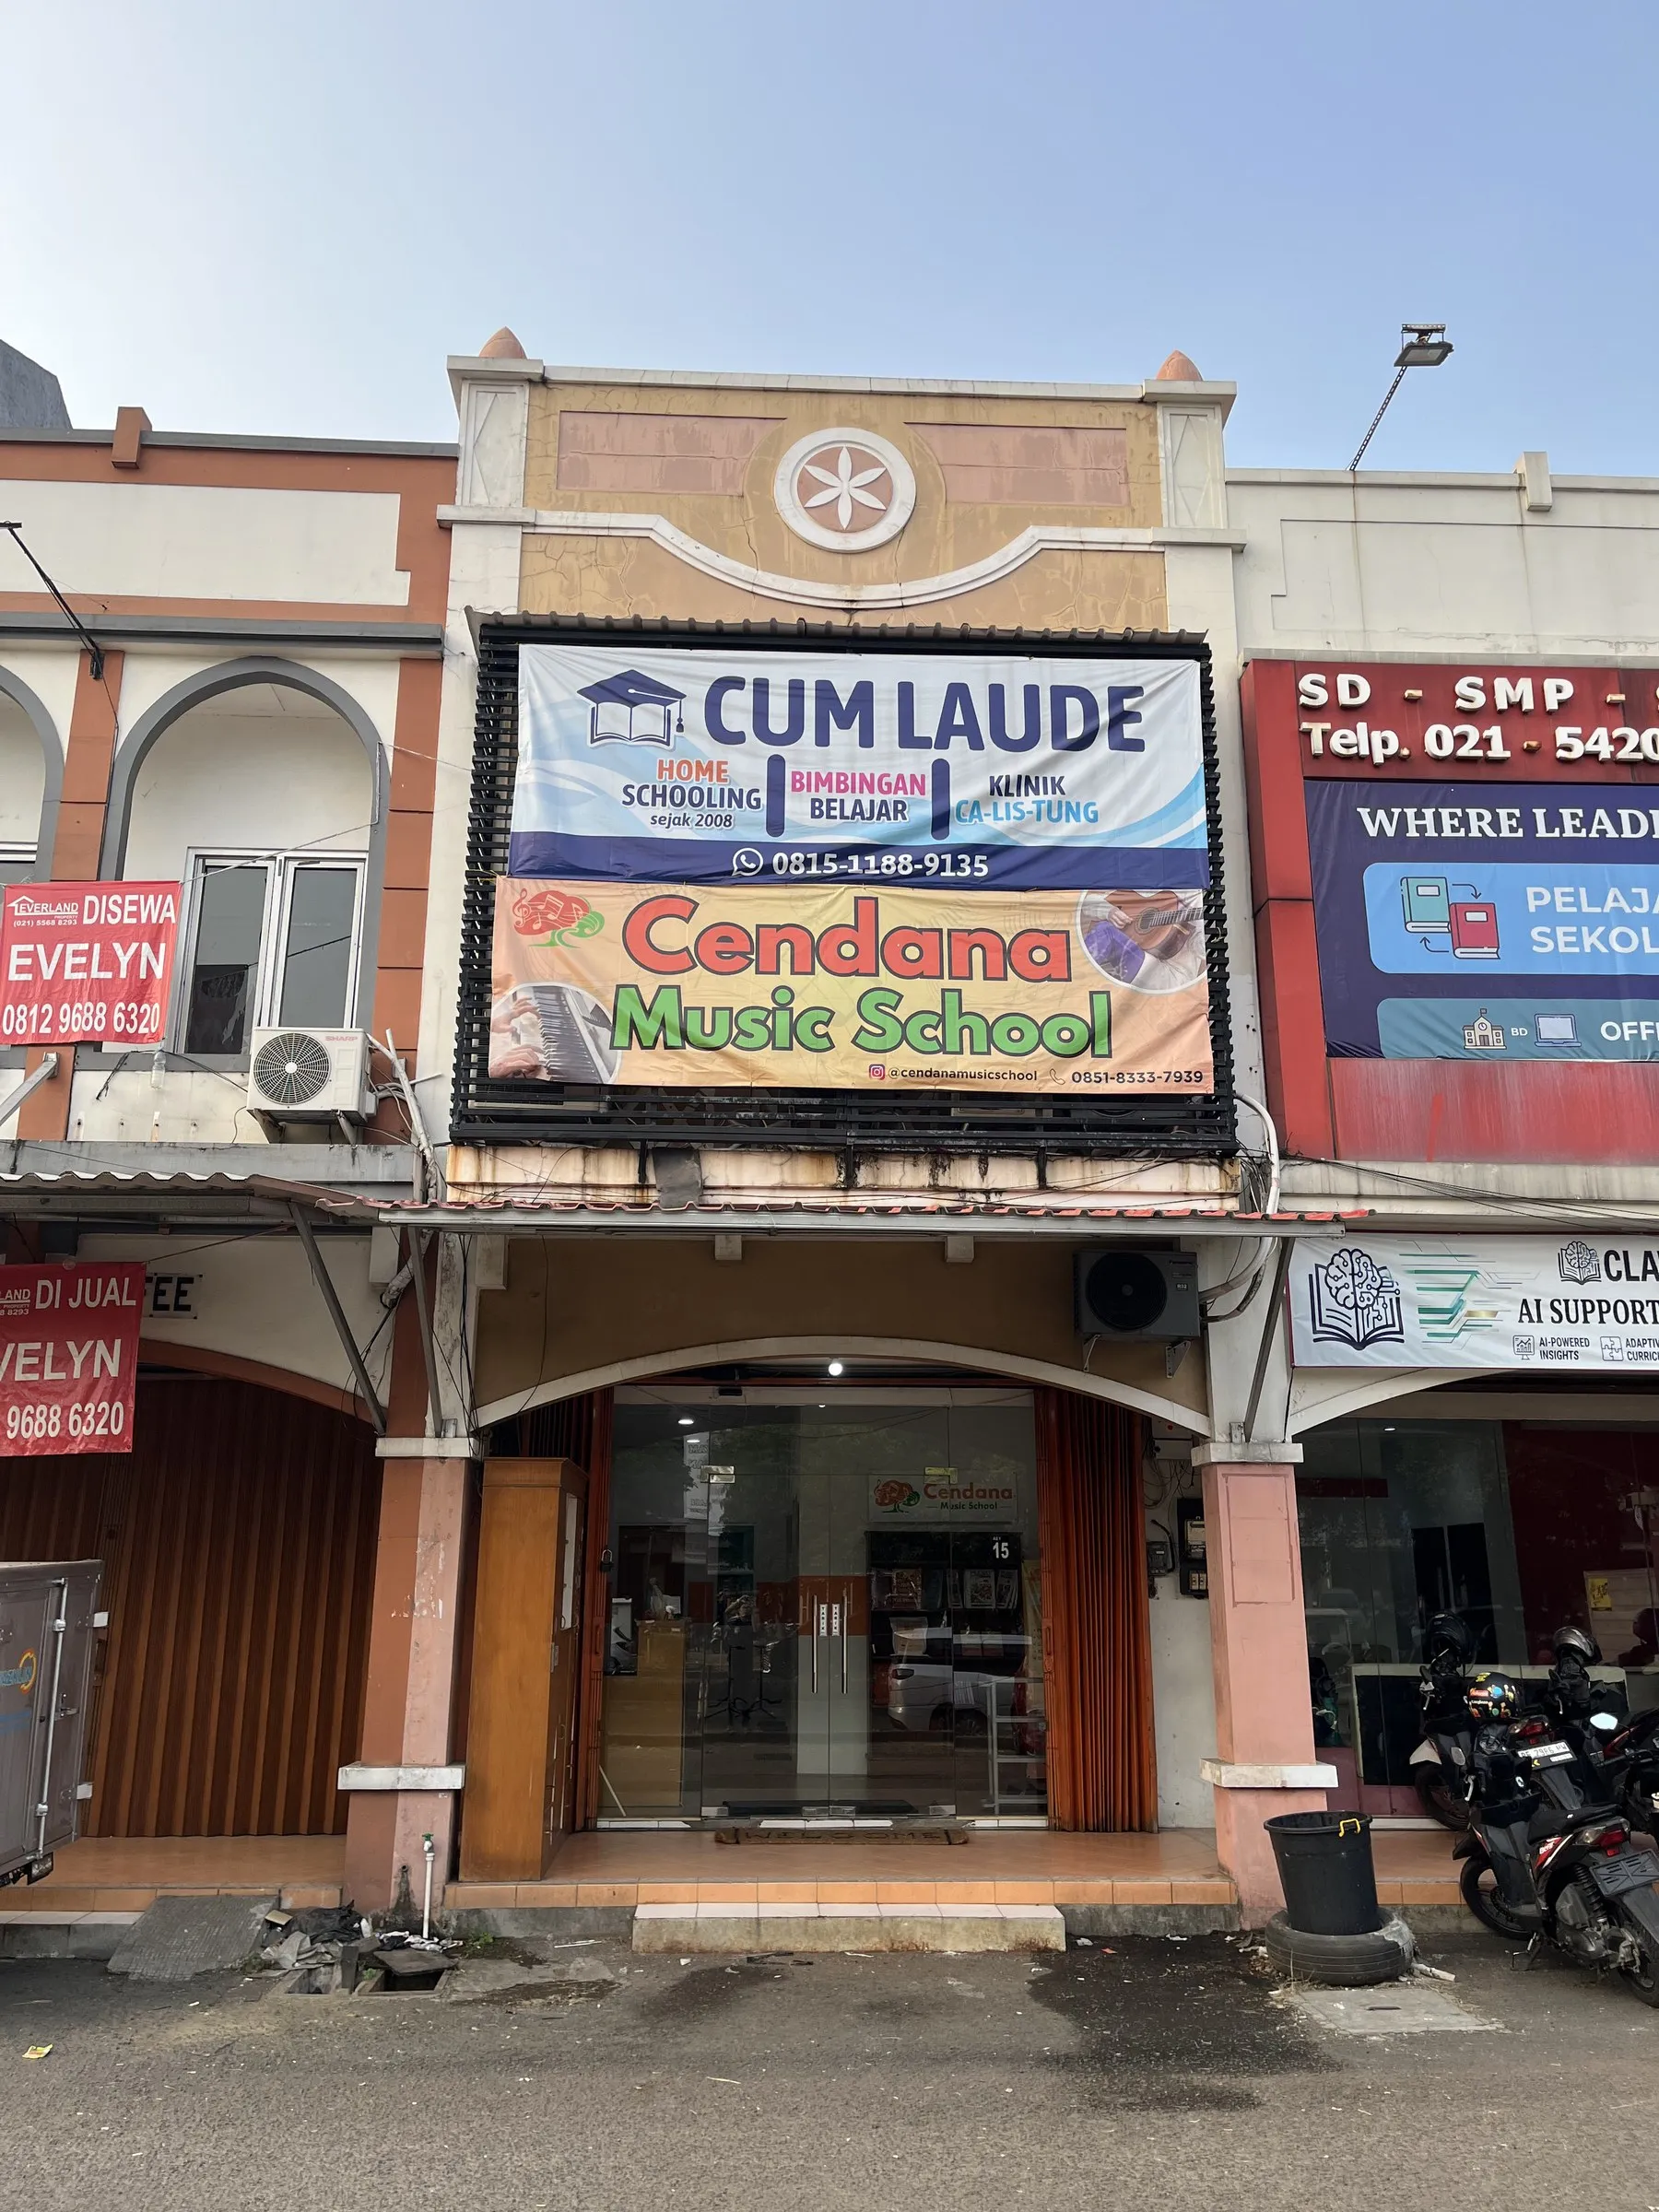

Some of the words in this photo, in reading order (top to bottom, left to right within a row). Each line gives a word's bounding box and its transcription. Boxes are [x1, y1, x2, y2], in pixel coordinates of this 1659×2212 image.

[1298, 673, 1371, 709] SD
[1454, 676, 1575, 712] SMP
[704, 676, 874, 747] CUM
[898, 681, 1146, 753] LAUDE
[1300, 722, 1412, 766] Telp.
[1424, 724, 1512, 760] 021
[1555, 726, 1659, 763] 5420
[657, 759, 730, 783] HOME
[791, 771, 926, 796] BIMBINGAN
[989, 774, 1066, 797] KLINIK
[621, 784, 761, 810] SCHOOLING
[810, 797, 908, 821] BELAJAR
[650, 813, 690, 830] sejak
[695, 813, 733, 828] 2008
[956, 800, 1099, 823] CA-LIS-TUNG
[1357, 807, 1524, 838] WHERE
[772, 853, 989, 877] 0815-1188-9135
[19, 902, 79, 912] EVERLAND
[82, 894, 176, 924] DISEWA
[14, 919, 34, 927] (021)
[622, 894, 1073, 982] Cendana
[7, 942, 167, 982] EVELYN
[2, 1004, 53, 1036] 0812
[58, 1001, 107, 1033] 9688
[112, 1002, 160, 1034] 6320
[609, 984, 836, 1053] Music
[851, 987, 1112, 1059] School
[888, 1067, 1038, 1081] @cendanamusicschool
[1072, 1070, 1204, 1084] 0851-8333-7939
[1604, 1250, 1659, 1282] CLA
[0, 1288, 30, 1300] AND
[35, 1279, 62, 1309] DI
[68, 1277, 136, 1308] JUAL
[1518, 1299, 1544, 1324] AI
[1539, 1336, 1590, 1347] AI-POWERED
[1540, 1350, 1579, 1360] INSIGHTS
[1627, 1351, 1659, 1361] CURRIC
[6, 1405, 62, 1439] 9688
[68, 1401, 124, 1437] 6320
[924, 1482, 1013, 1500] Cendana
[940, 1501, 966, 1510] Music
[969, 1501, 998, 1510] School
[993, 1542, 1009, 1559] 15
